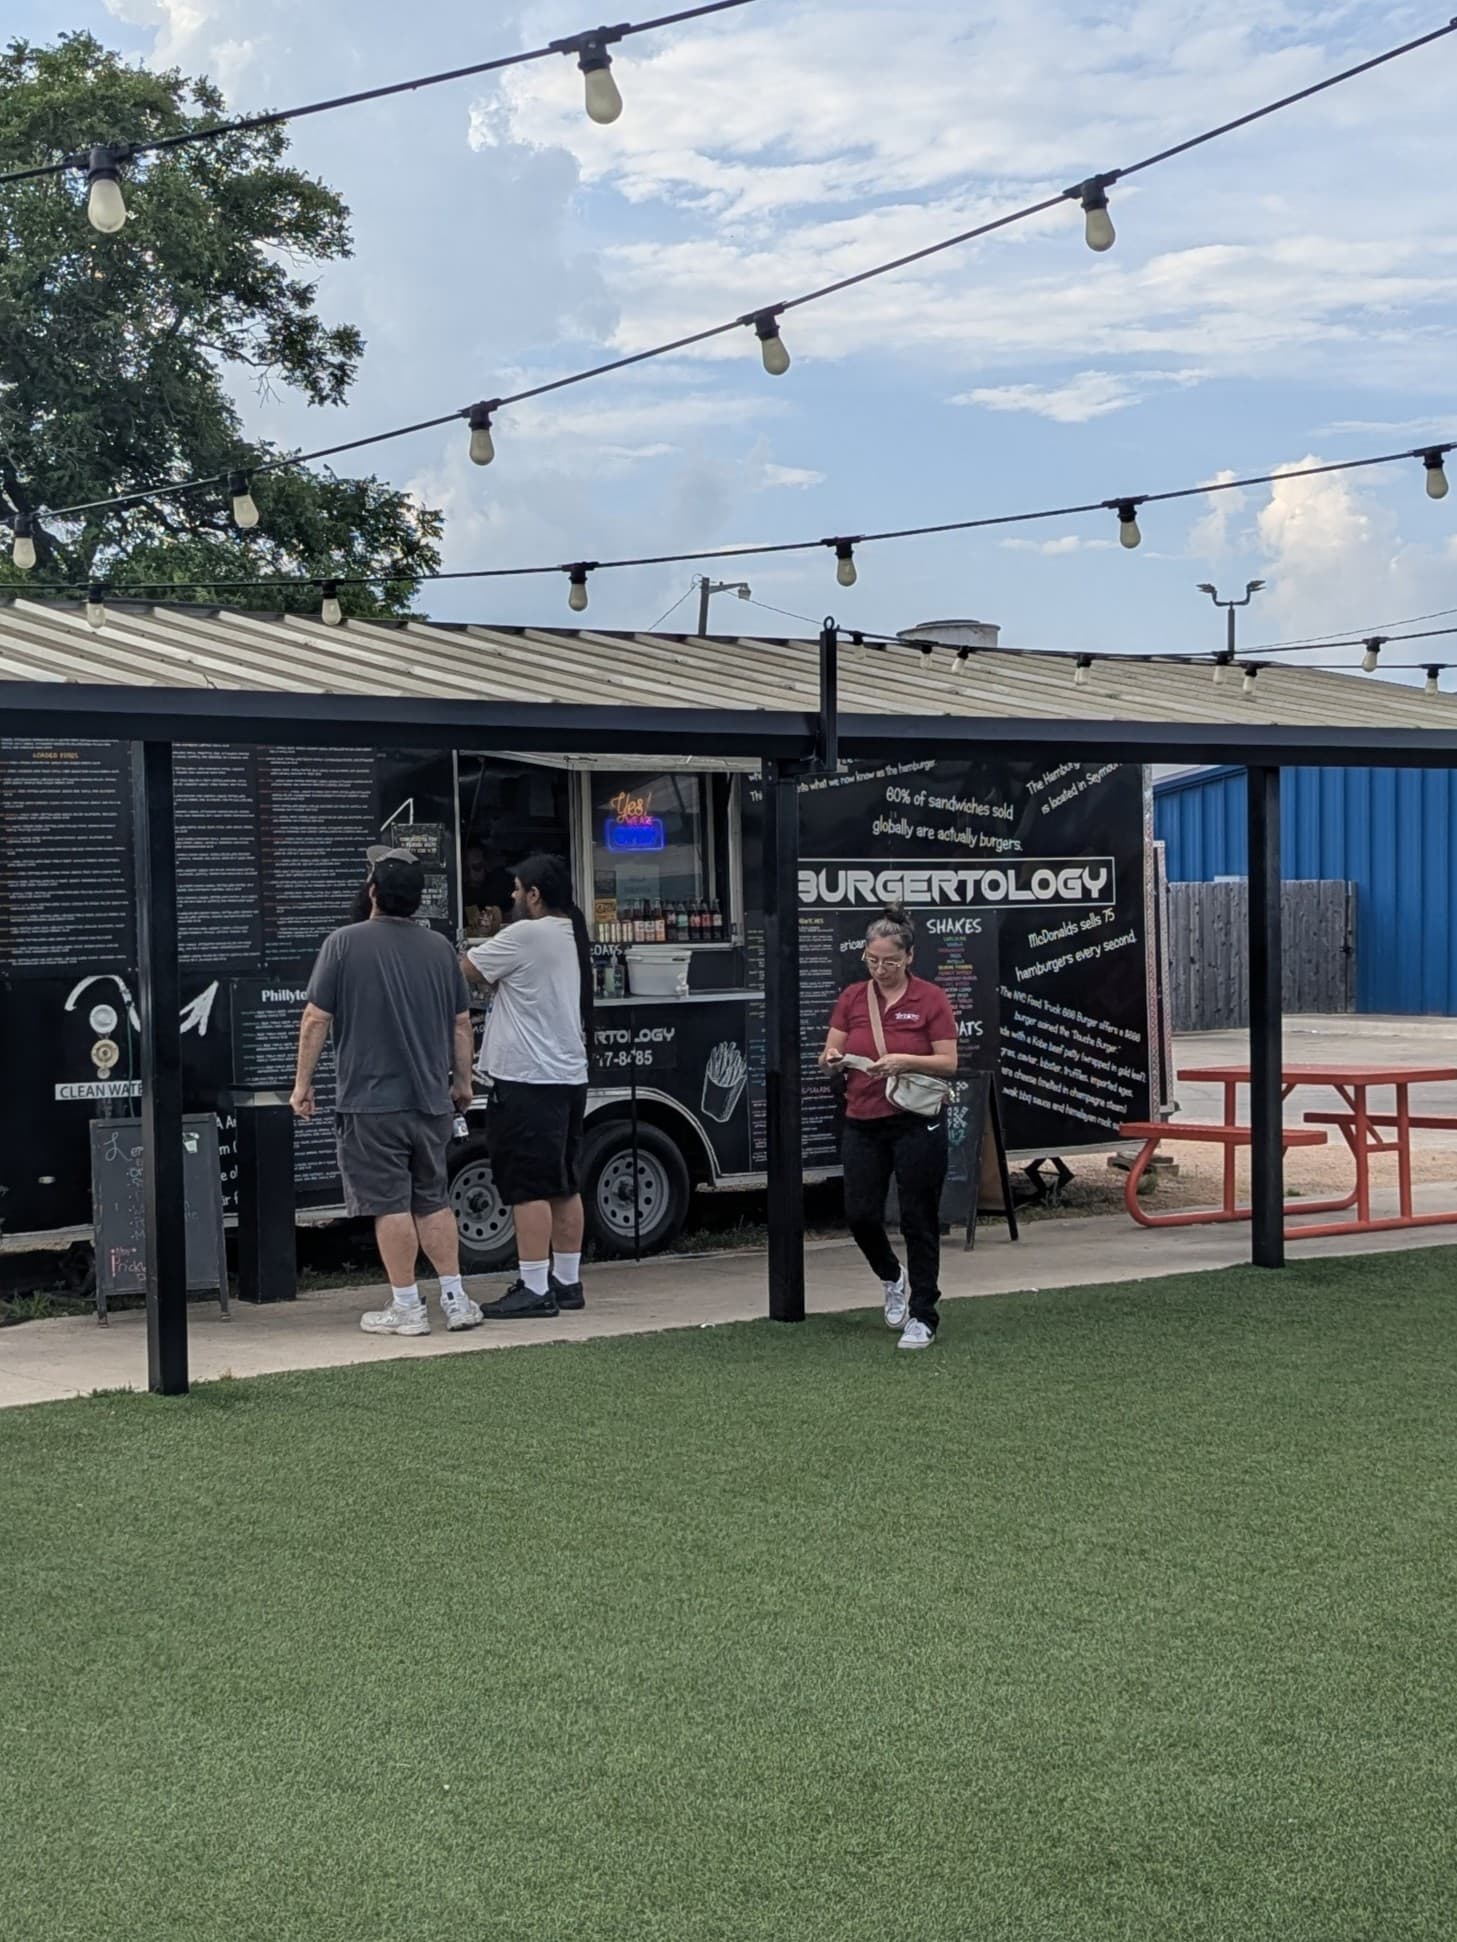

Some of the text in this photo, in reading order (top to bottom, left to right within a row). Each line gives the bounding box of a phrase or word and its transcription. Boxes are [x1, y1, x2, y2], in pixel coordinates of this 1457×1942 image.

[855, 770, 875, 782] know
[885, 764, 898, 776] the
[1026, 780, 1044, 795] The
[610, 791, 652, 824] Yes!
[886, 786, 1014, 821] 60% of sandwiches sold
[1041, 803, 1051, 815] is
[1048, 782, 1079, 810] located
[1076, 780, 1088, 792] in
[871, 814, 1024, 853] globally are actually burgers.
[798, 866, 1107, 905] BURGERTOLOGY
[926, 917, 982, 934] SHAKES
[1027, 907, 1115, 949] McDonalds sells 75
[1015, 952, 1075, 983] hamburgers
[1075, 944, 1102, 962] every
[1013, 1010, 1037, 1027] burger
[1026, 993, 1043, 1010] Food
[1043, 999, 1061, 1016] Truck
[1076, 1010, 1099, 1029] Burger
[60, 1084, 106, 1099] CLEAN
